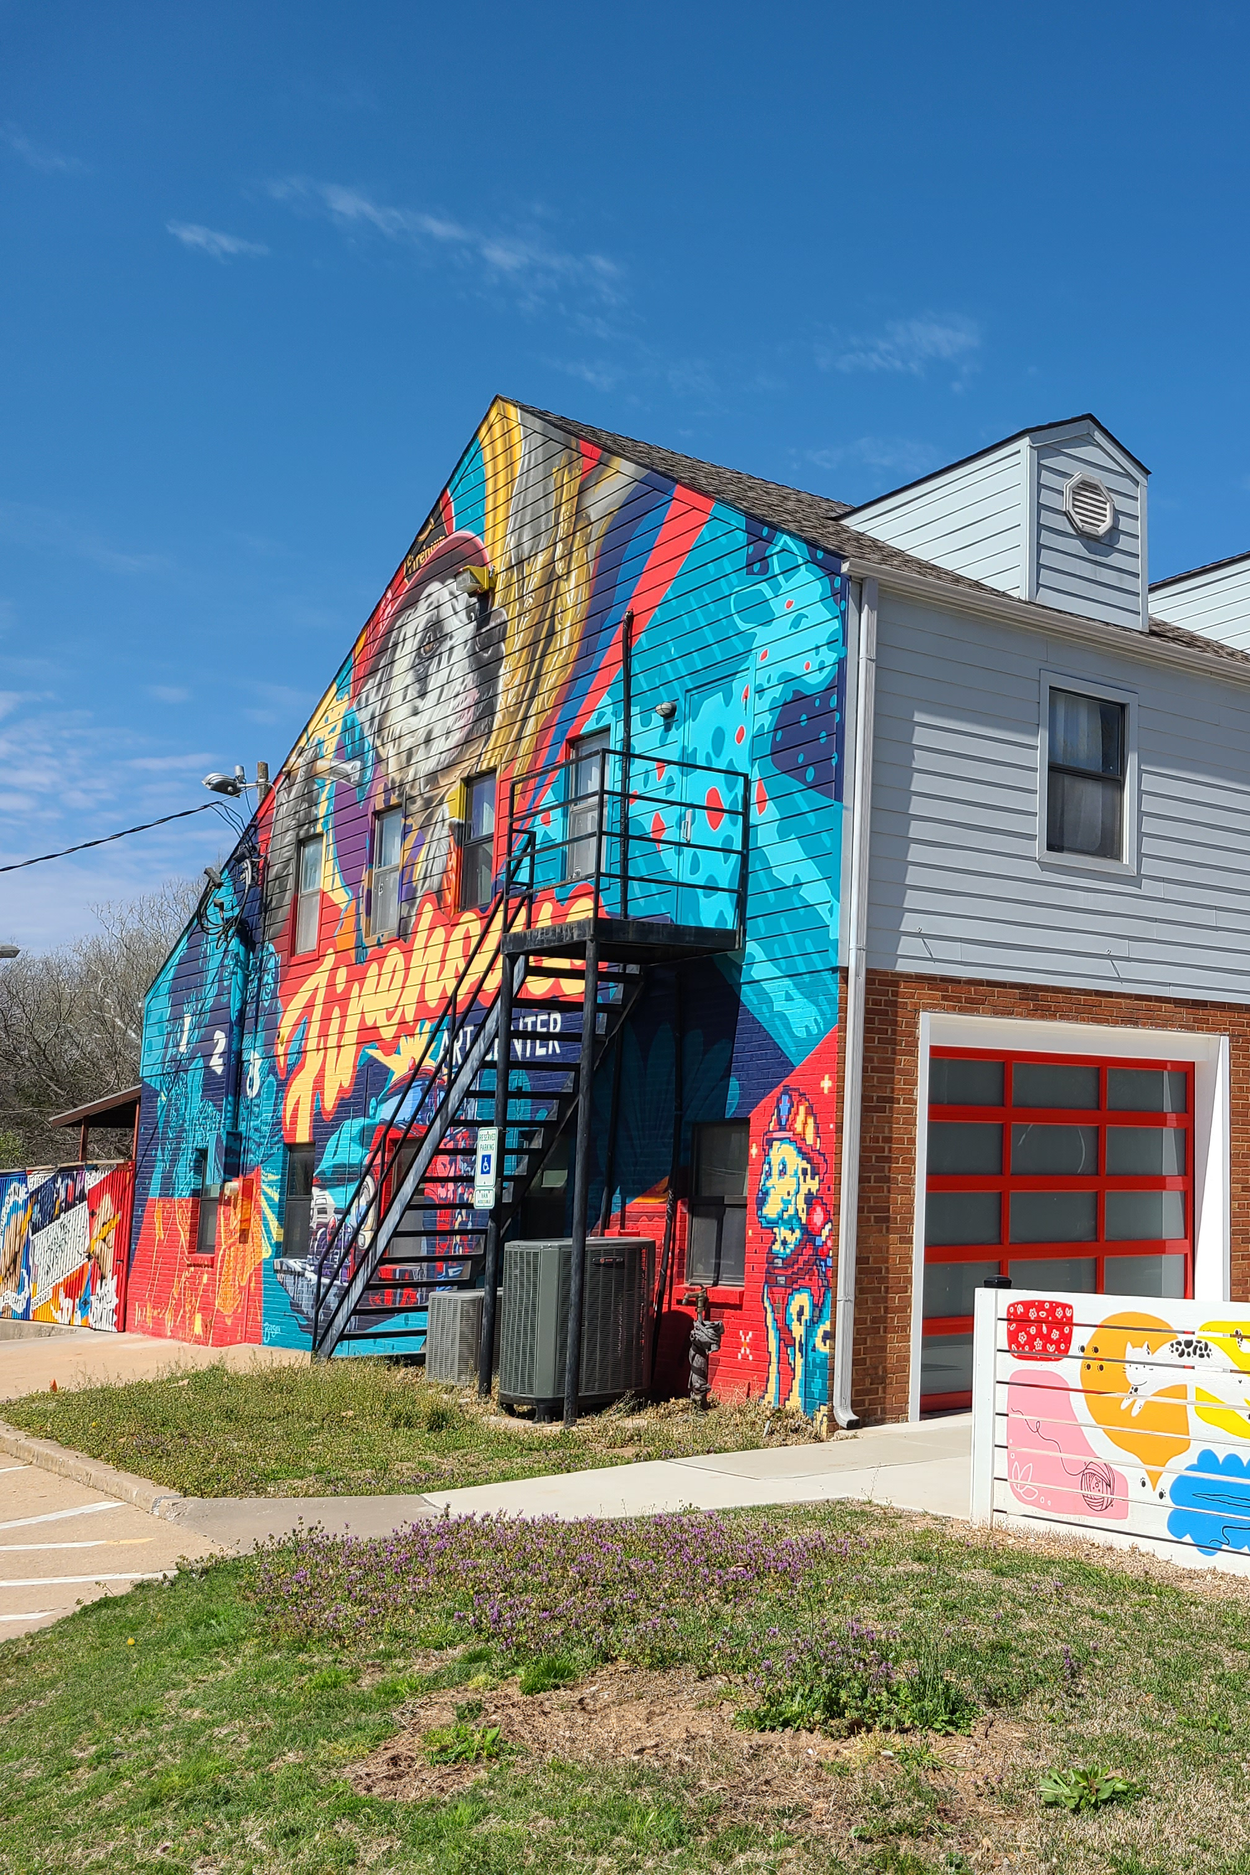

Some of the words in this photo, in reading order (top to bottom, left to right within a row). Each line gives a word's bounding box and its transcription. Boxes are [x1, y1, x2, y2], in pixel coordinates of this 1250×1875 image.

[208, 1030, 226, 1075] 2
[436, 1025, 475, 1066] ART
[484, 1011, 562, 1061] NTER
[479, 1133, 495, 1141] RESERVED
